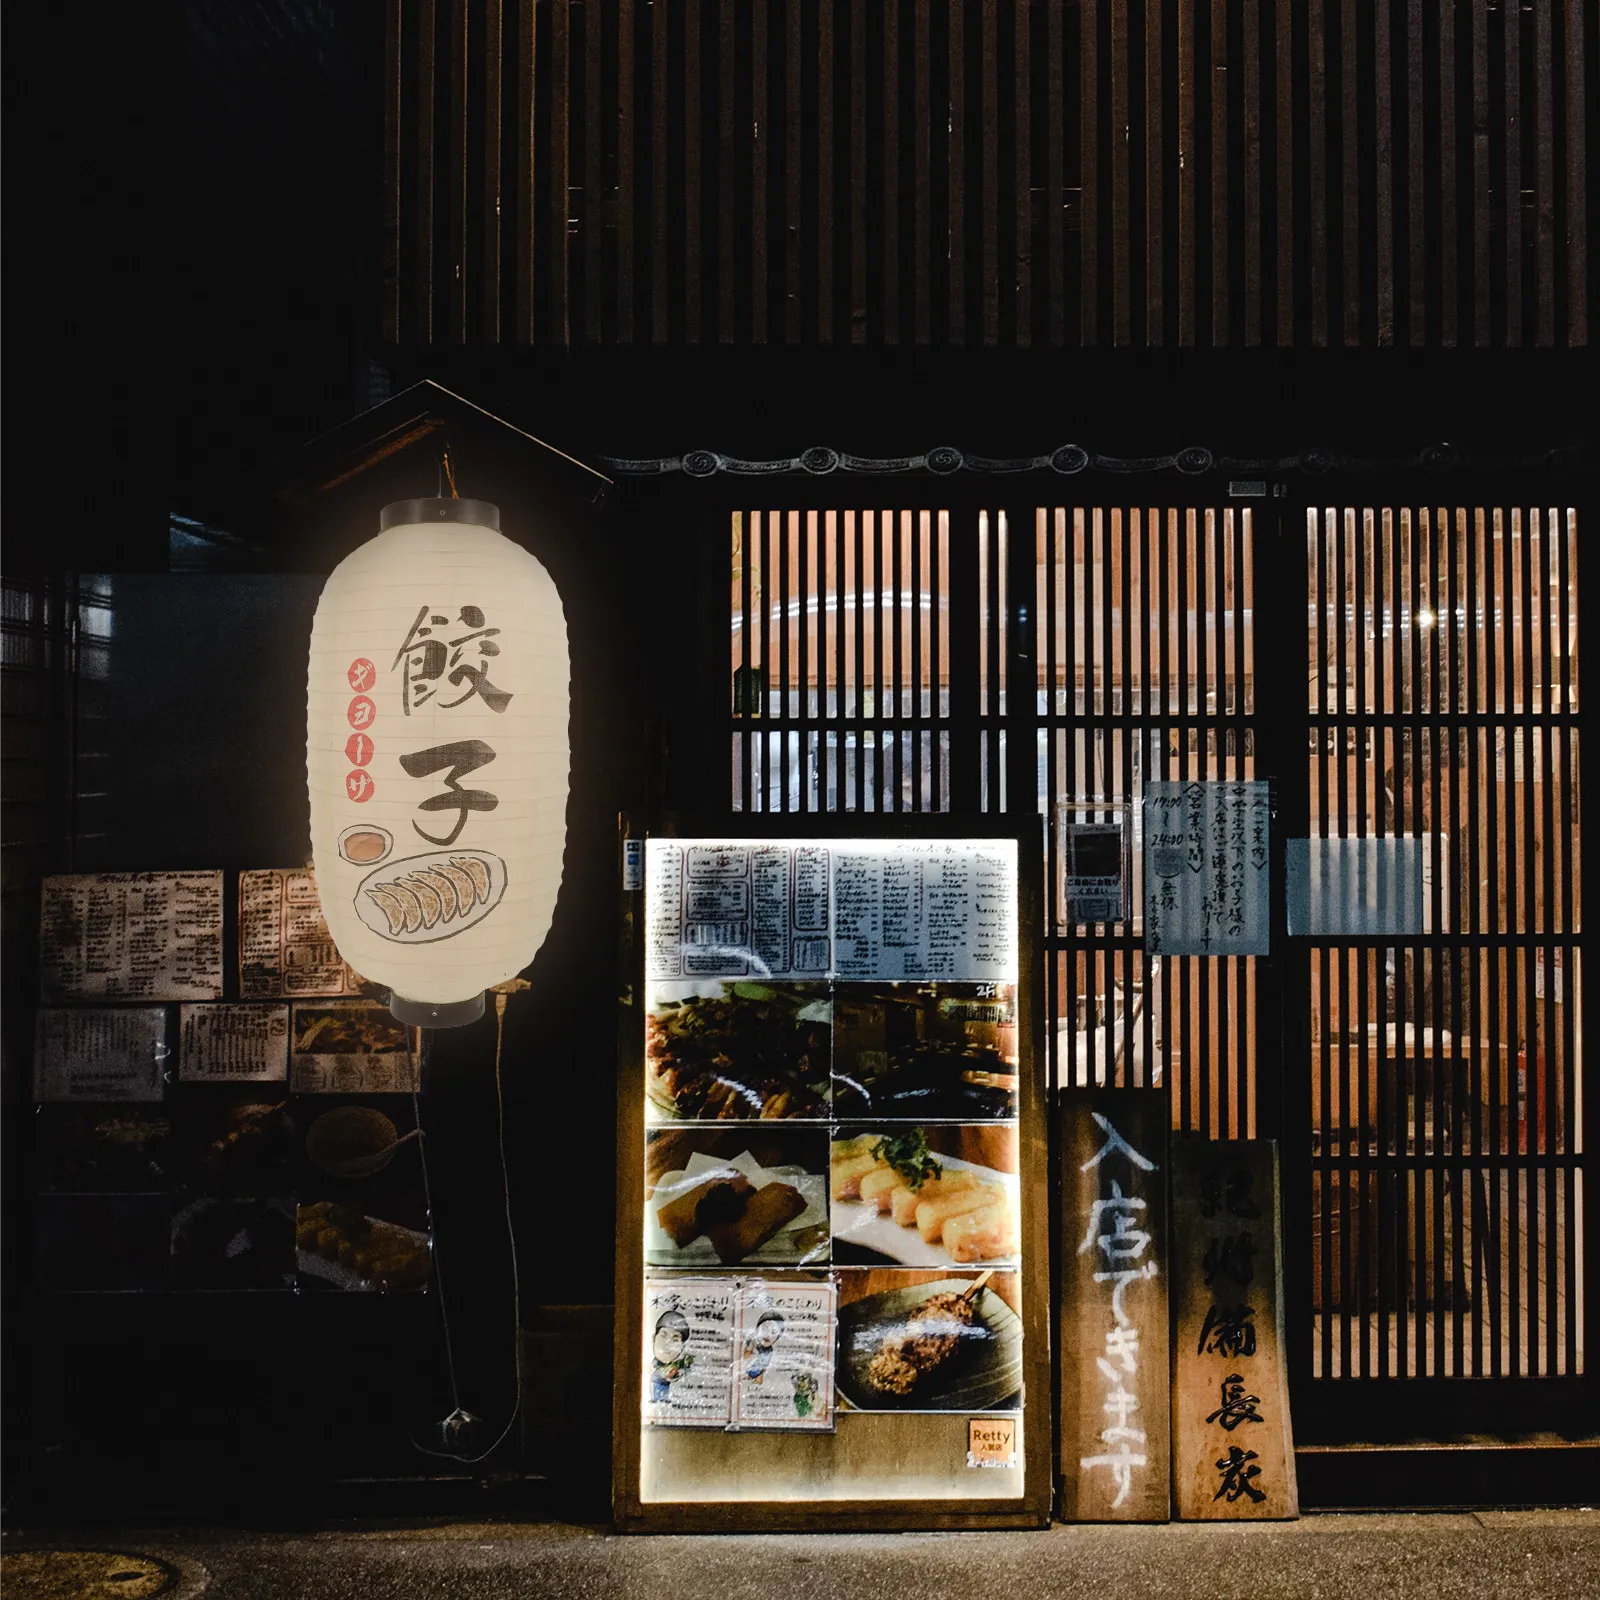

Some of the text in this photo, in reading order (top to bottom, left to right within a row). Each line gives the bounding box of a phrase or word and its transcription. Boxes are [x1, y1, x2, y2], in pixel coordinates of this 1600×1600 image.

[349, 661, 374, 802] ギョーザ
[391, 605, 514, 846] 餃子
[1077, 1111, 1160, 1509] 入店できます
[973, 1429, 1011, 1445] Retty
